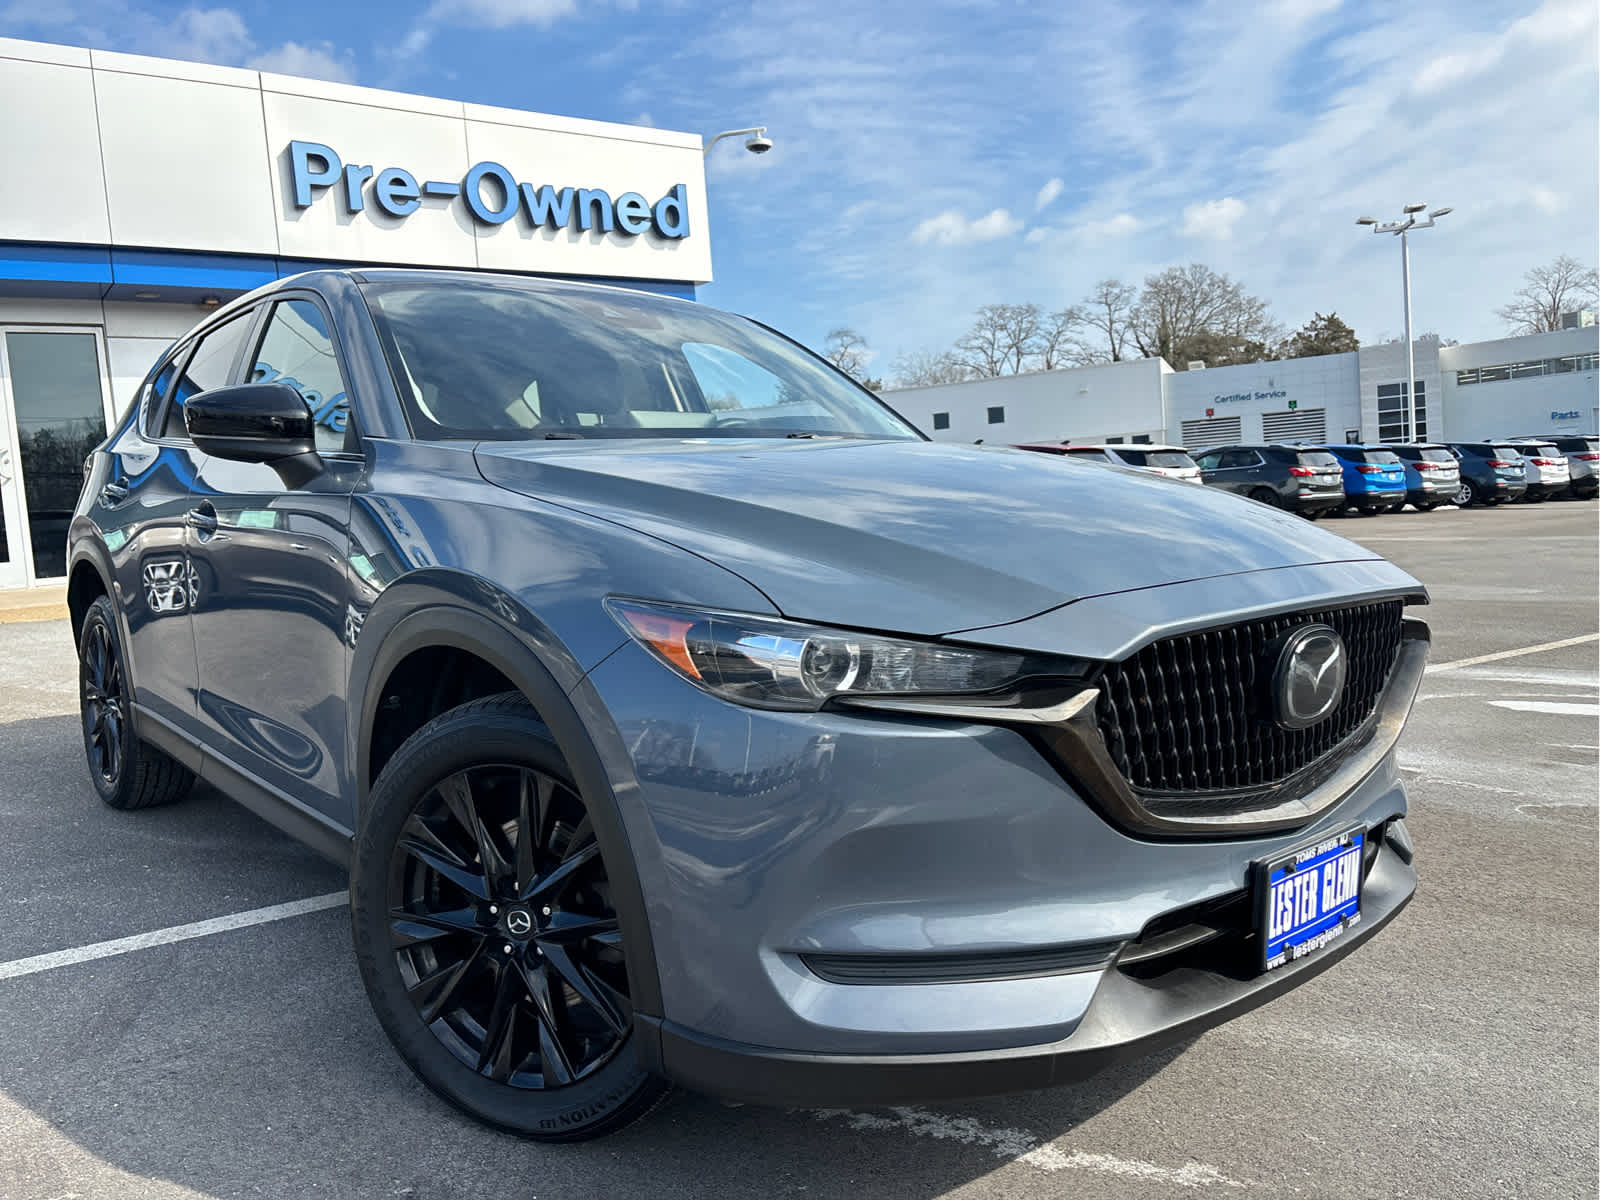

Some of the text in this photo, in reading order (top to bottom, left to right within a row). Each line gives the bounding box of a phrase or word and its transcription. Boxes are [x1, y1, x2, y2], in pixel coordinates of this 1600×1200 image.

[290, 140, 690, 240] Pre-Owned
[1214, 390, 1286, 403] Certified Service
[1551, 411, 1580, 420] Parts
[1295, 847, 1317, 864] TOMS
[1339, 833, 1349, 846] NJ
[1268, 849, 1360, 939] LESTER GLENN
[1293, 924, 1343, 959] lesterglenn
